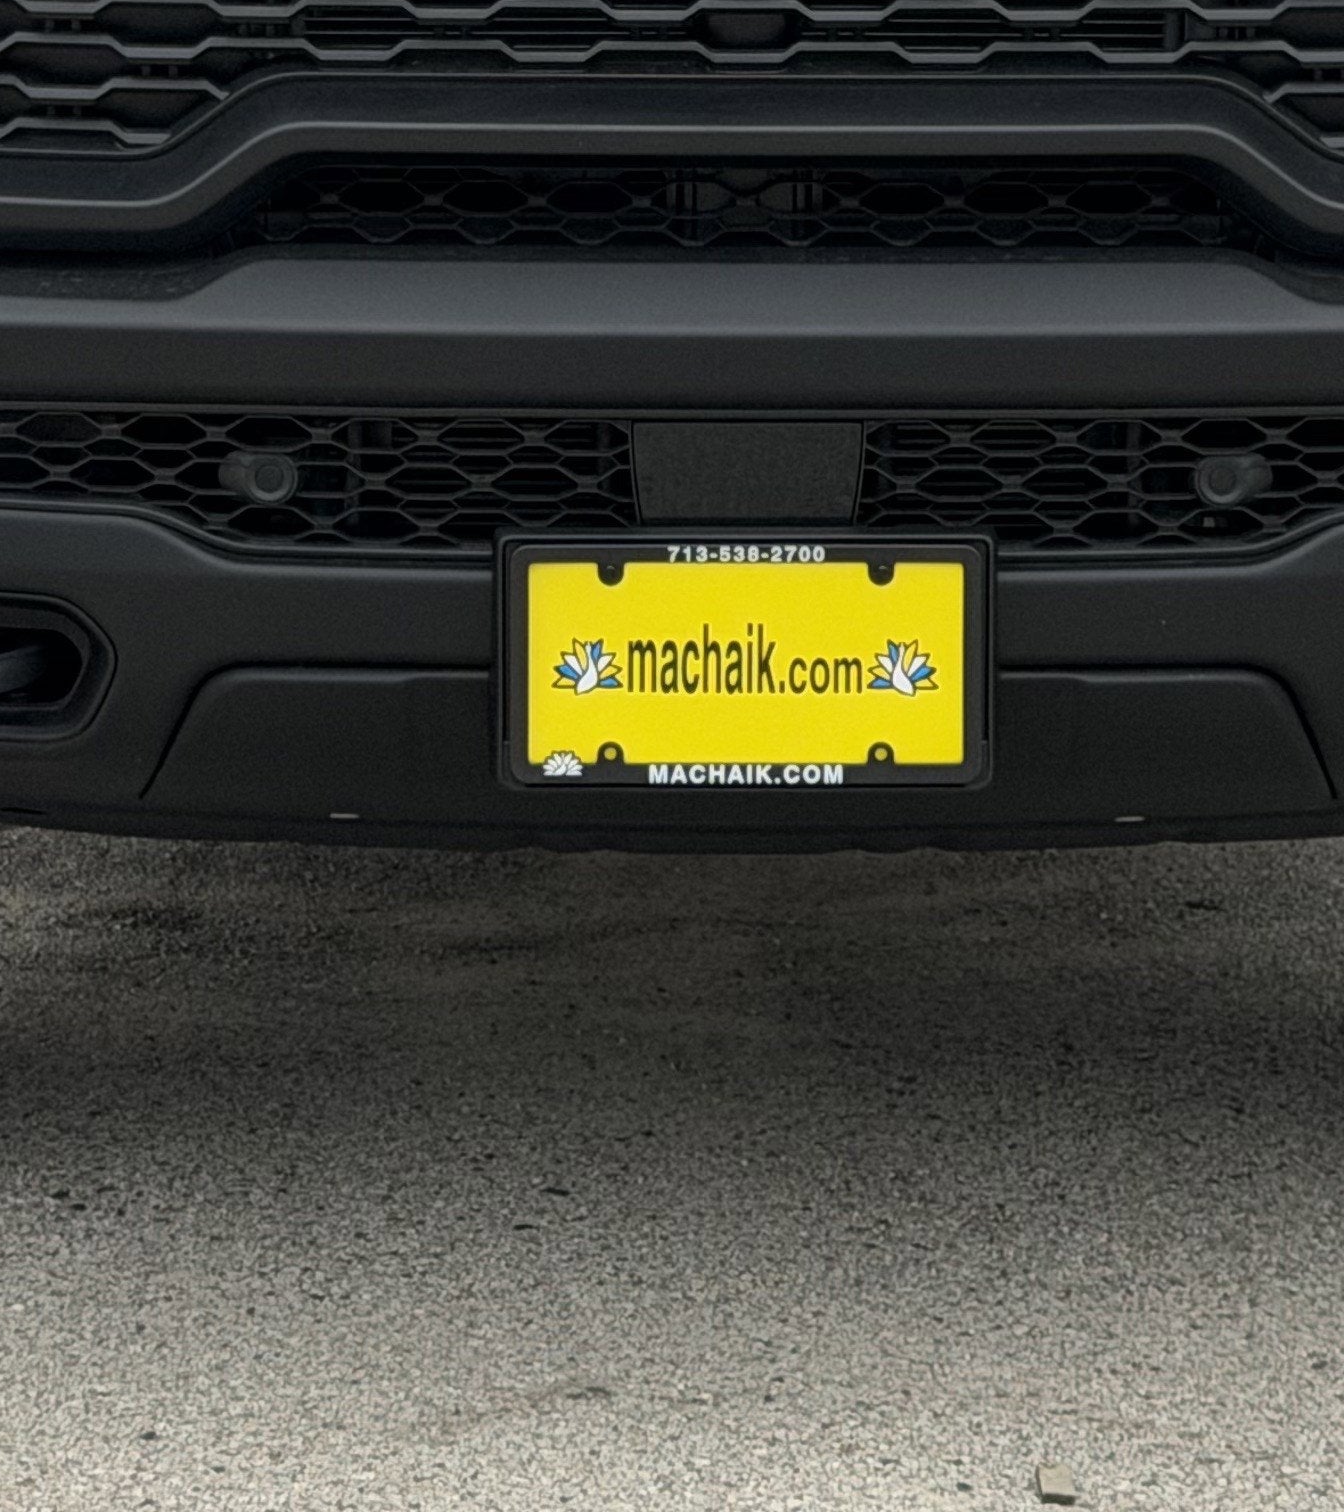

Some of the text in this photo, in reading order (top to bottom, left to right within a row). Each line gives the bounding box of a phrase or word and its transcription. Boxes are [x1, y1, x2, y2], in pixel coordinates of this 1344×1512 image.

[667, 544, 826, 563] 713-538-2700
[626, 623, 863, 694] machaik.com
[648, 764, 844, 785] MACHAIK.COM
